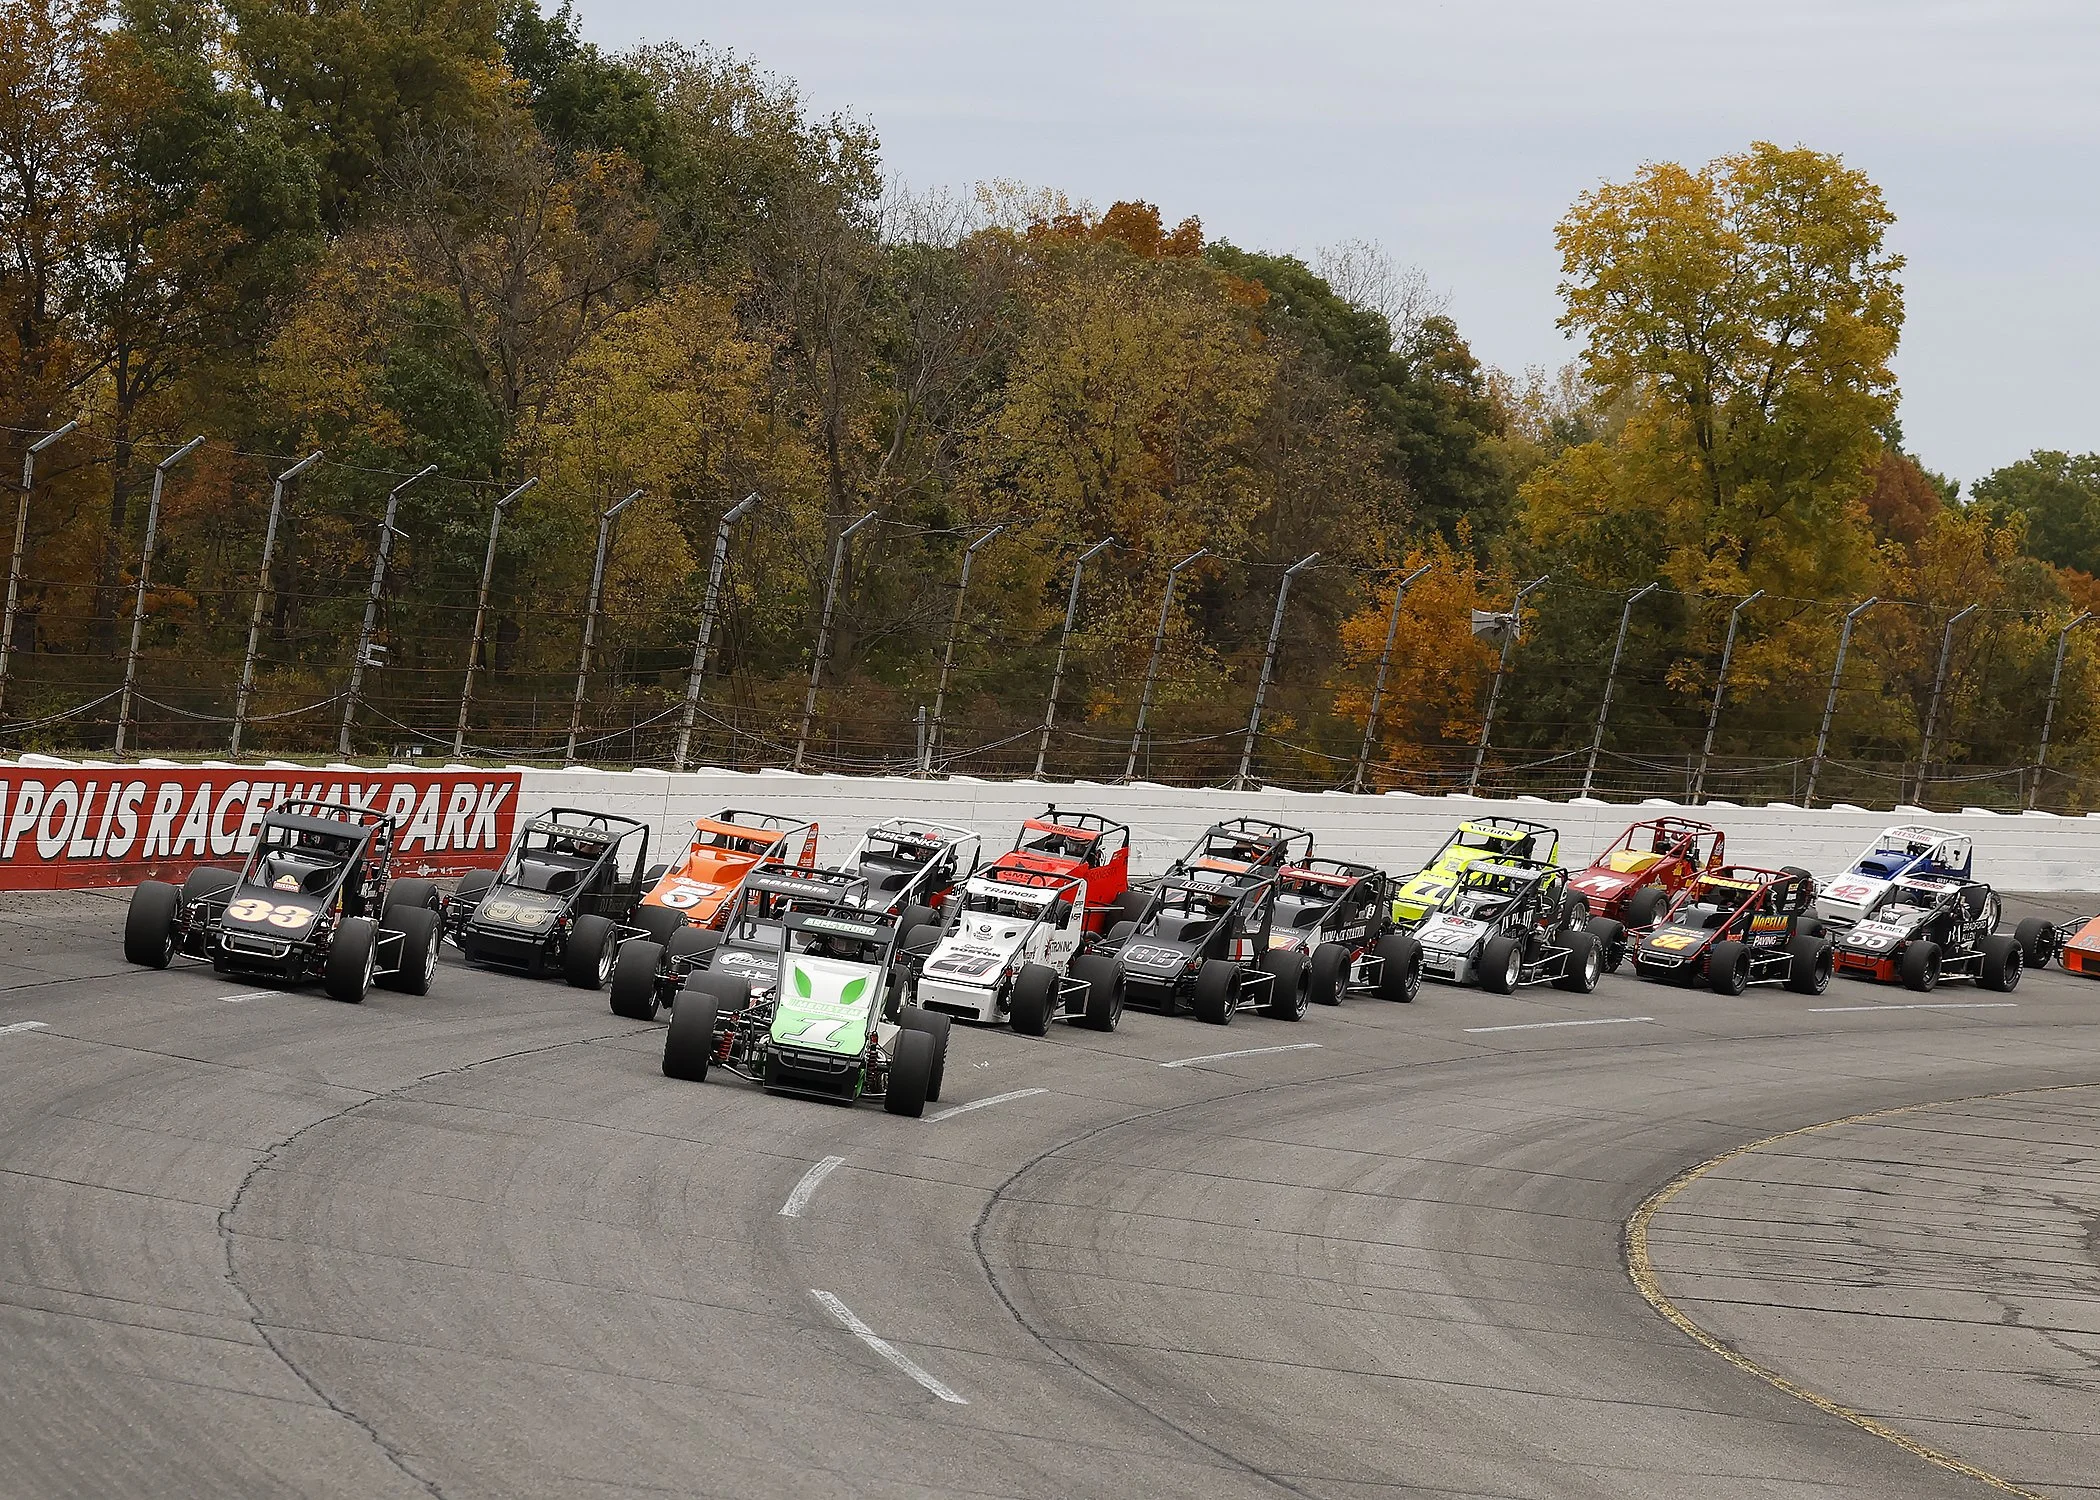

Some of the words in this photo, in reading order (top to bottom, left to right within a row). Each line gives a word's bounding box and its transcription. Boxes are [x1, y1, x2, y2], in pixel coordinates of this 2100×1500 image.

[0, 780, 147, 861] POLIS
[375, 782, 516, 852] PARK
[532, 821, 609, 841] Santos
[1470, 825, 1514, 837] VAUGHN
[983, 885, 1038, 899] TRAINOR
[1180, 880, 1222, 893] LOCKE
[1832, 884, 1872, 900] 42
[660, 884, 717, 909] 5
[229, 898, 315, 928] 33
[803, 917, 878, 936] ARMSTRONG
[1963, 920, 1988, 932] BRADFORD
[1753, 936, 1777, 947] PAVING
[1846, 932, 1893, 949] 55
[950, 946, 1001, 958] BOSTON
